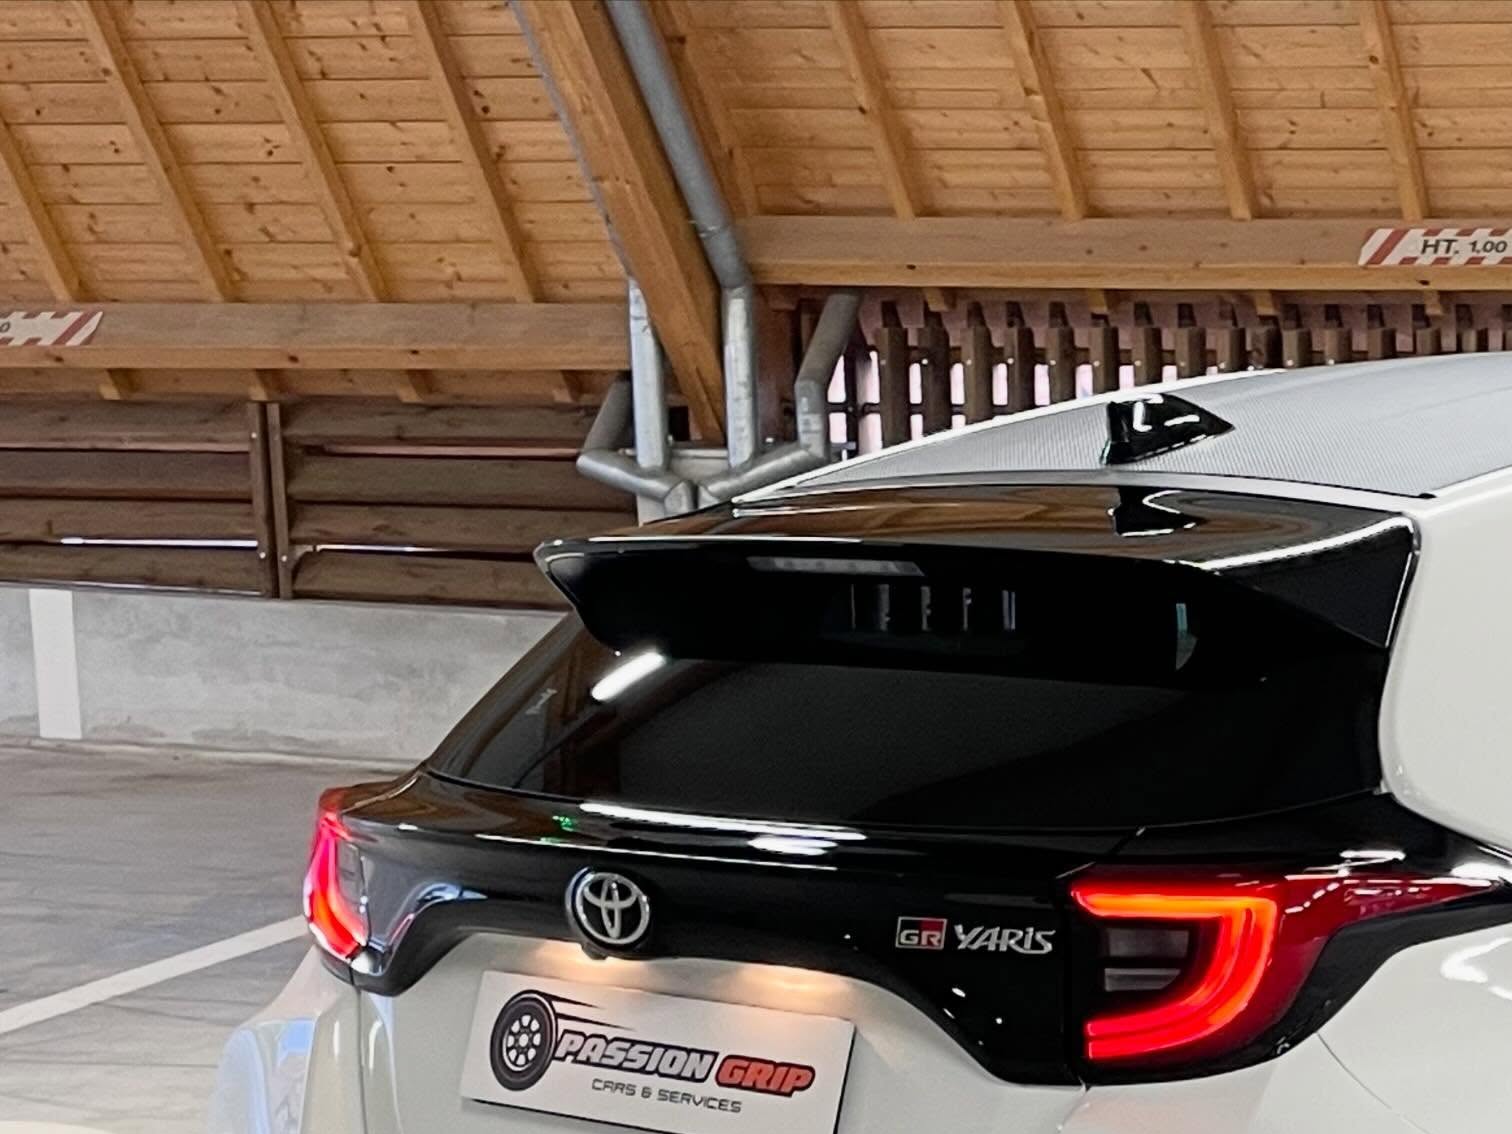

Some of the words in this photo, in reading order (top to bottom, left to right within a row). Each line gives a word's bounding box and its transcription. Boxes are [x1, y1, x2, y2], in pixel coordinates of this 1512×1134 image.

[1421, 239, 1460, 254] HT.
[1468, 240, 1508, 253] 1.00
[899, 929, 943, 947] GR
[954, 924, 1056, 954] YARIS
[555, 1029, 718, 1083] PASSION
[715, 1054, 815, 1097] GRIP
[592, 1078, 637, 1096] CARS
[641, 1086, 652, 1098] &
[656, 1088, 741, 1113] SERVICES
